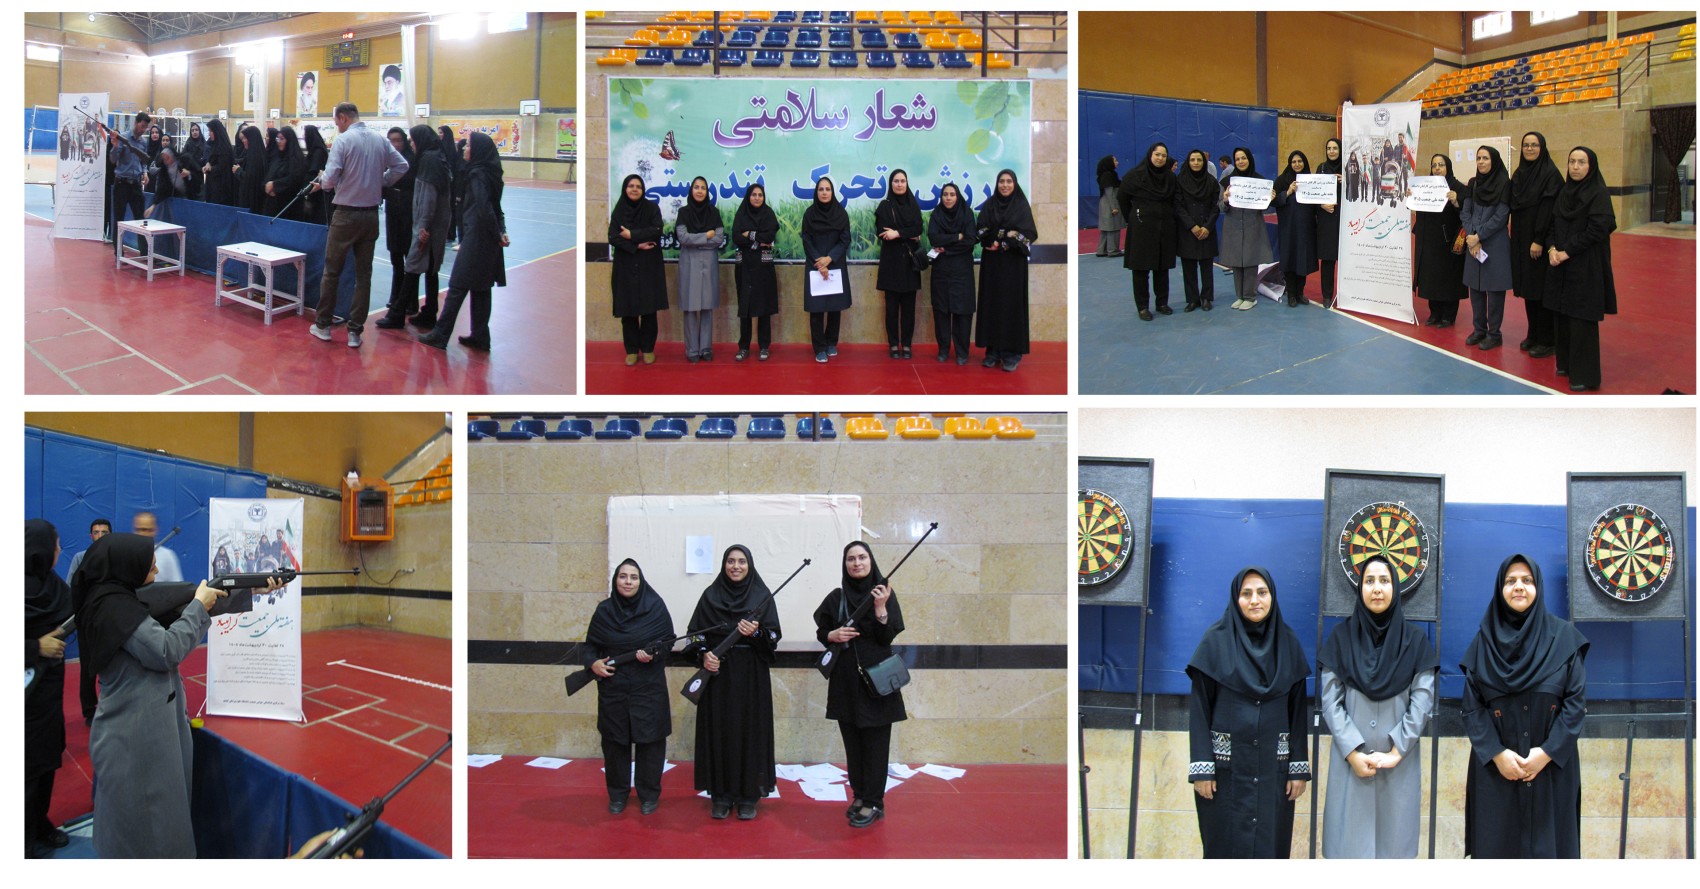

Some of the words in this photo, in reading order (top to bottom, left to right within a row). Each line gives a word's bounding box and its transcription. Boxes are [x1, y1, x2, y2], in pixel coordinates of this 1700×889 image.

[712, 86, 851, 148] سلامتی
[855, 87, 939, 142] شعار
[792, 163, 889, 209] تحرک
[914, 164, 993, 213] رزش
